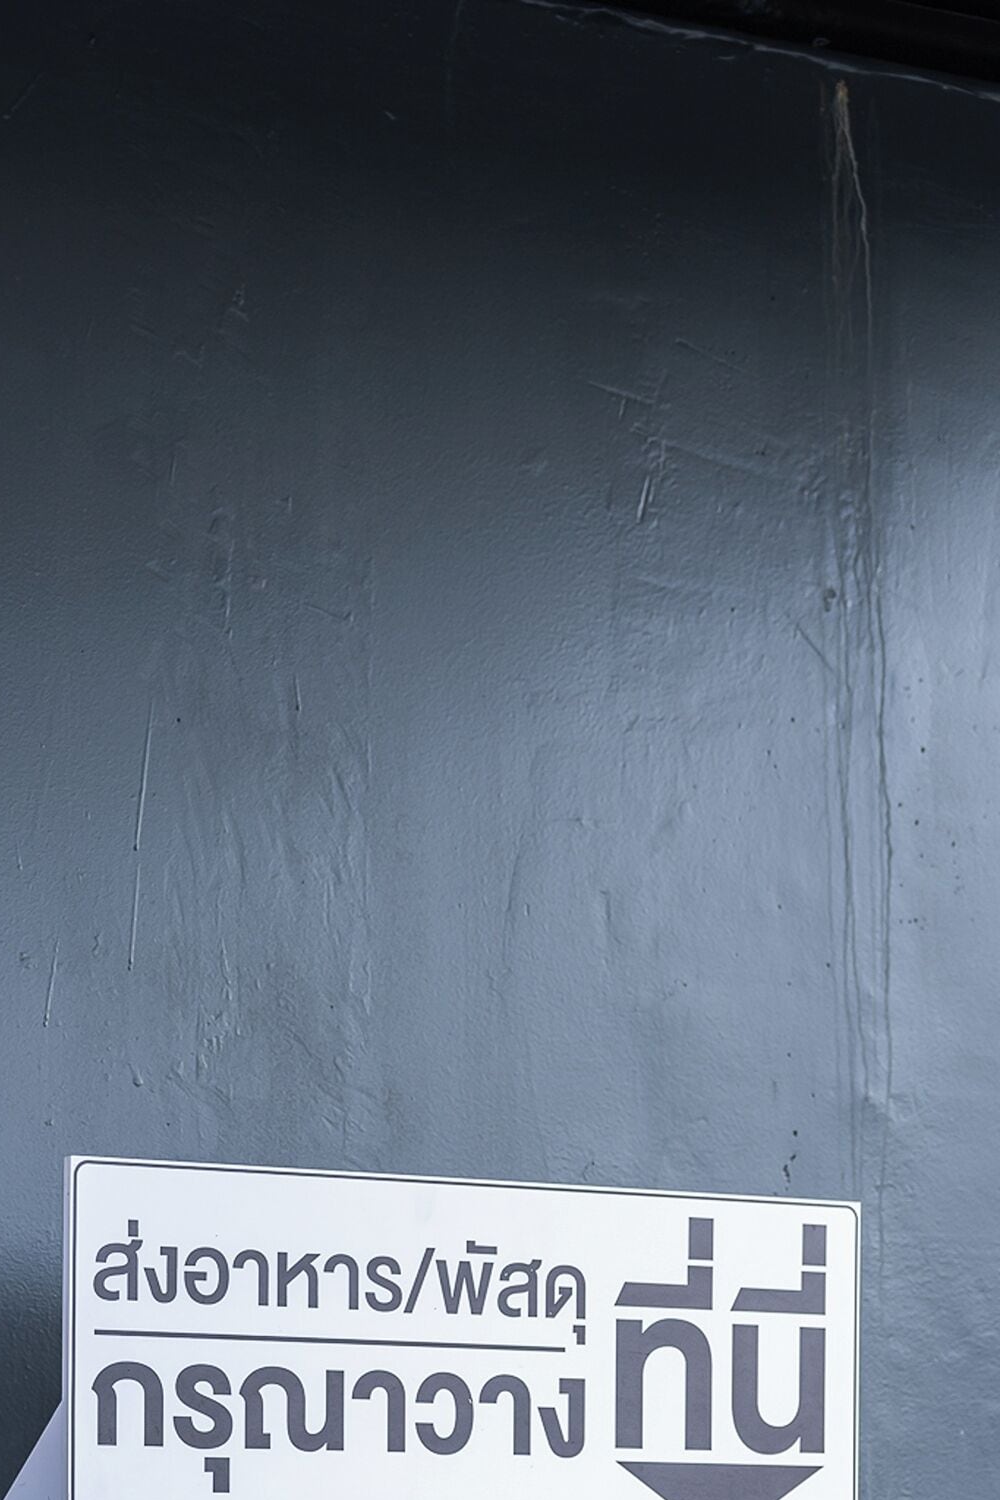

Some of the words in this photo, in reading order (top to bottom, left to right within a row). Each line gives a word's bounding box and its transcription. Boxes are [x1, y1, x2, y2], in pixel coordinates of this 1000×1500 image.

[93, 1219, 588, 1345] ส่งอาหาร/พัสดุ
[614, 1216, 827, 1454] ที่นี่
[92, 1360, 587, 1493] กรุณาวาง
